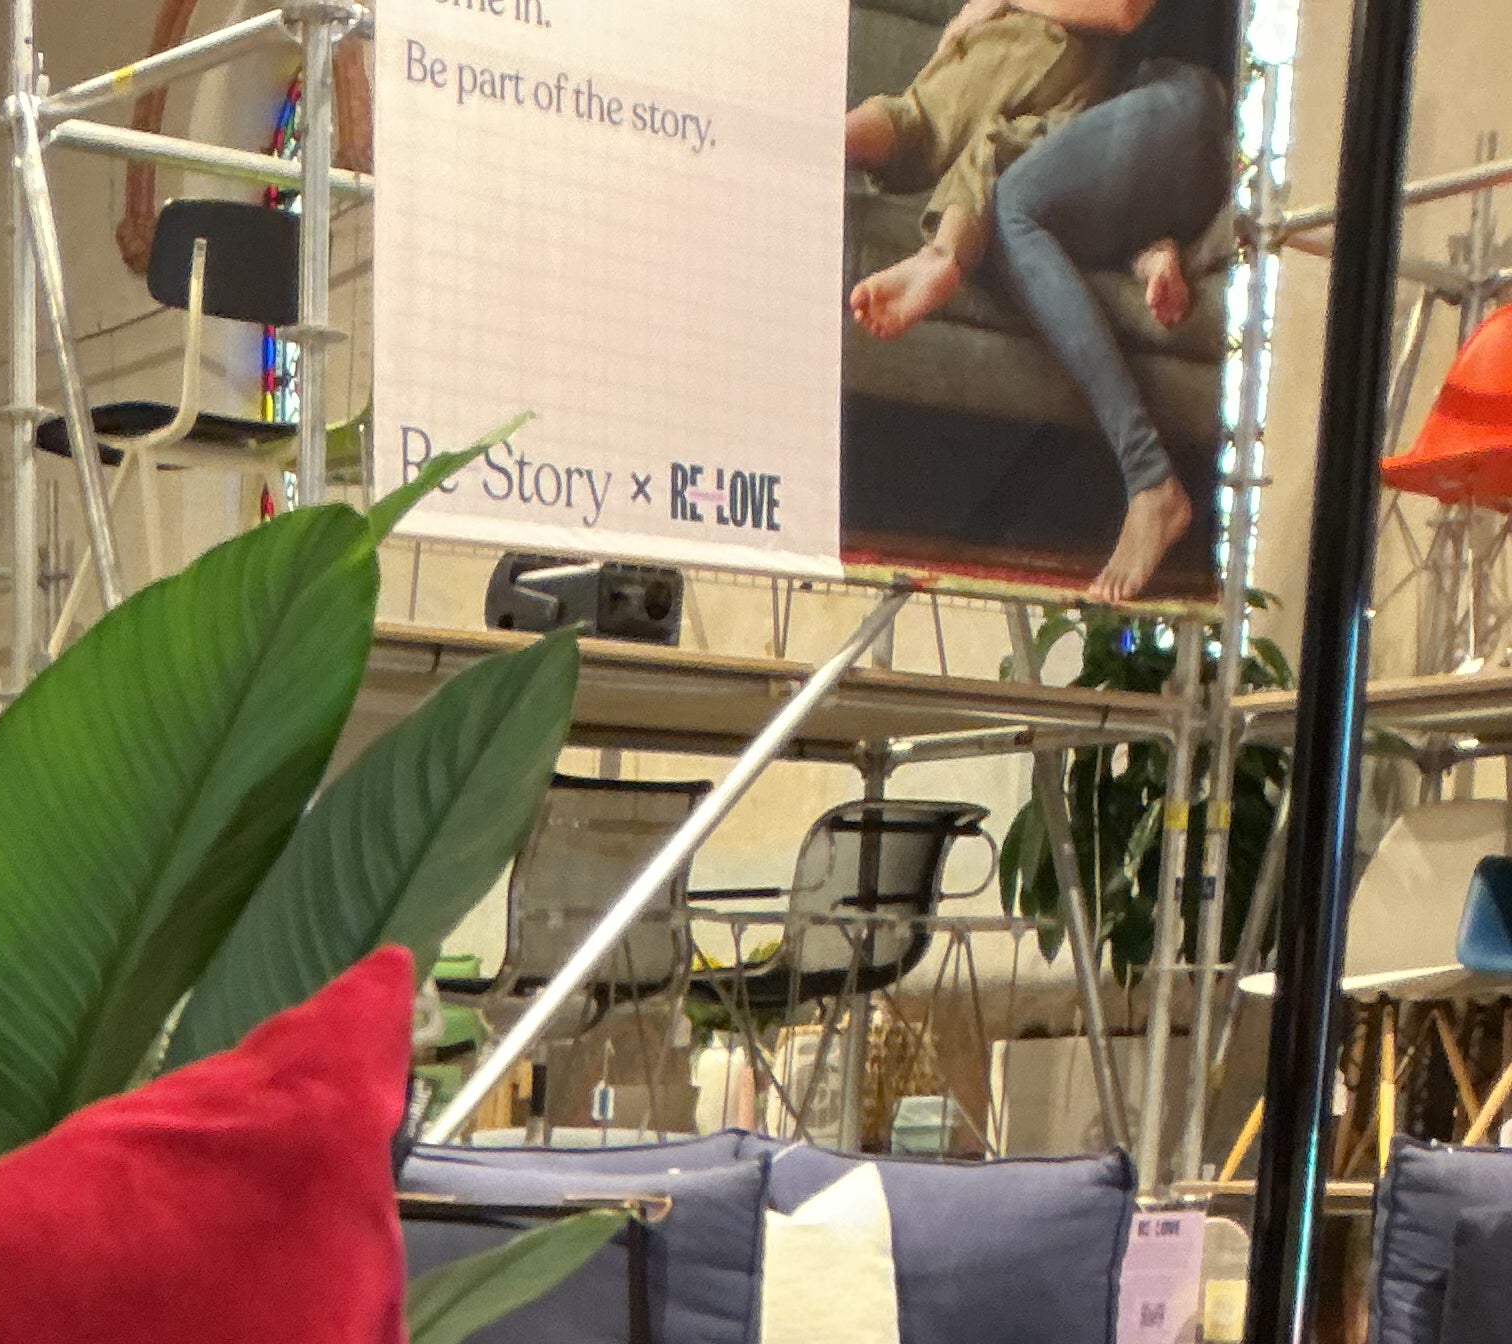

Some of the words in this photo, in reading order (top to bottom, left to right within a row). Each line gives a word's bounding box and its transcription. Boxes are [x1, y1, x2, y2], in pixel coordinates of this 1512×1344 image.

[406, 38, 448, 89] Be
[456, 62, 525, 105] part
[533, 71, 569, 114] of
[574, 78, 623, 127] the
[631, 100, 717, 154] story.
